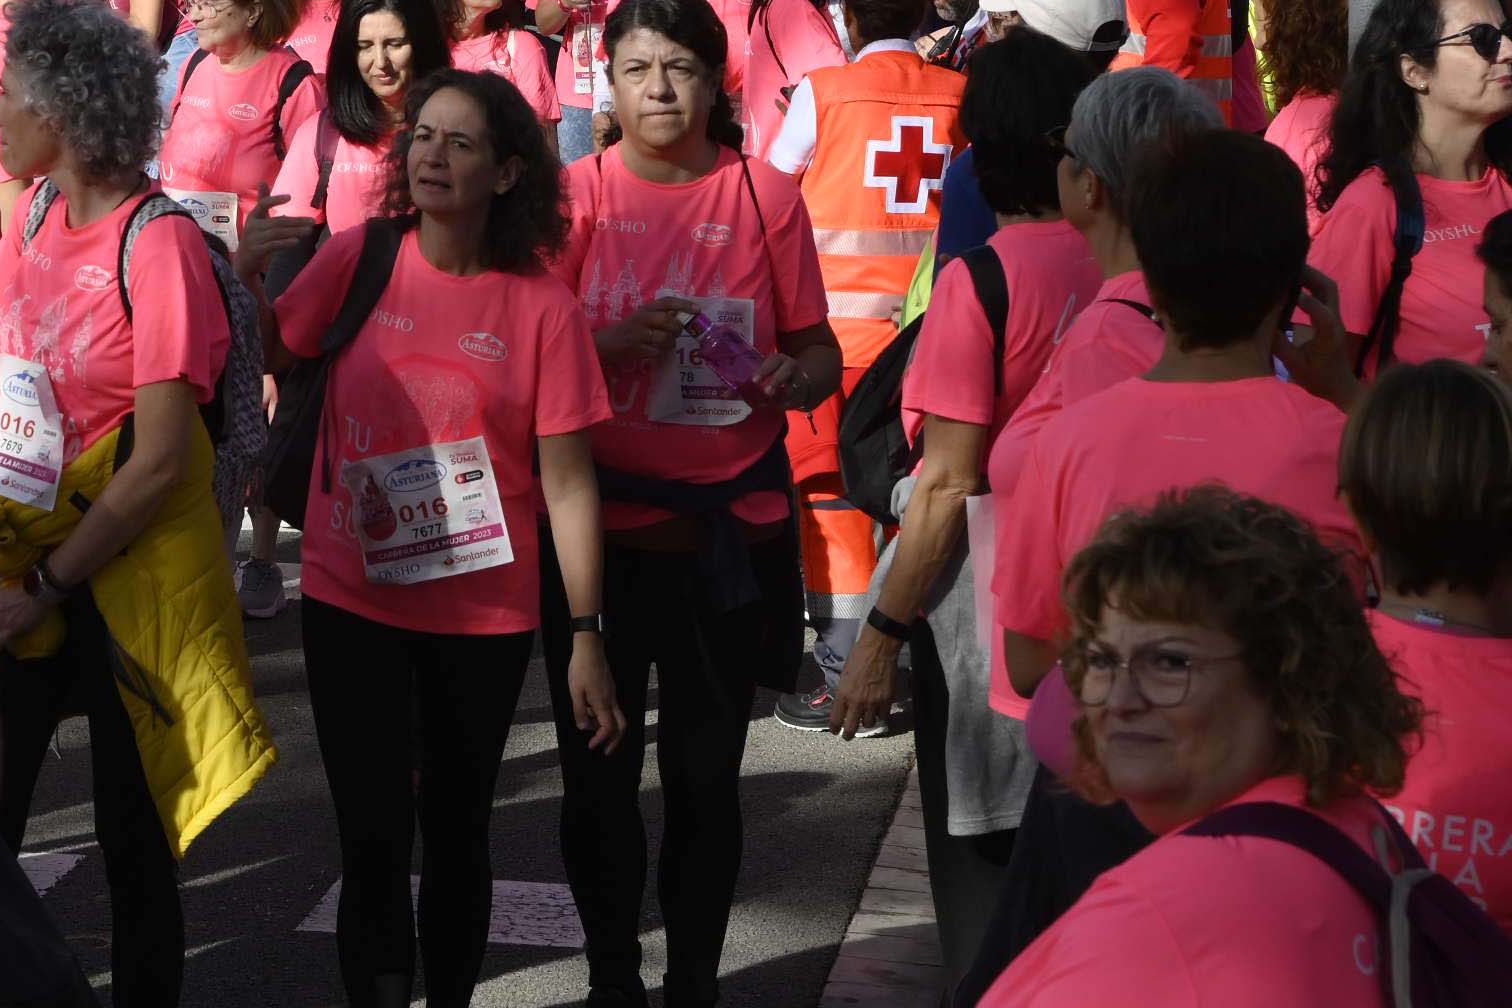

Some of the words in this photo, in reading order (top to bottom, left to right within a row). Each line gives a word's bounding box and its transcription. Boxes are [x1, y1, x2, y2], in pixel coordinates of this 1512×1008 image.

[696, 405, 743, 417] Santander
[0, 411, 37, 439] 016
[344, 415, 372, 453] TU
[0, 438, 23, 455] 7679
[3, 456, 13, 467] LA
[450, 454, 479, 466] SUMA
[389, 470, 444, 488] ASTURIANA
[398, 496, 450, 524] 016
[411, 522, 443, 540] 7677
[376, 546, 414, 562] CARRERA
[415, 543, 428, 553] DE
[429, 541, 440, 551] LA
[441, 534, 471, 547] MUJER
[472, 528, 492, 540] 2023
[454, 547, 500, 565] Santander
[377, 563, 421, 581] OYSHO
